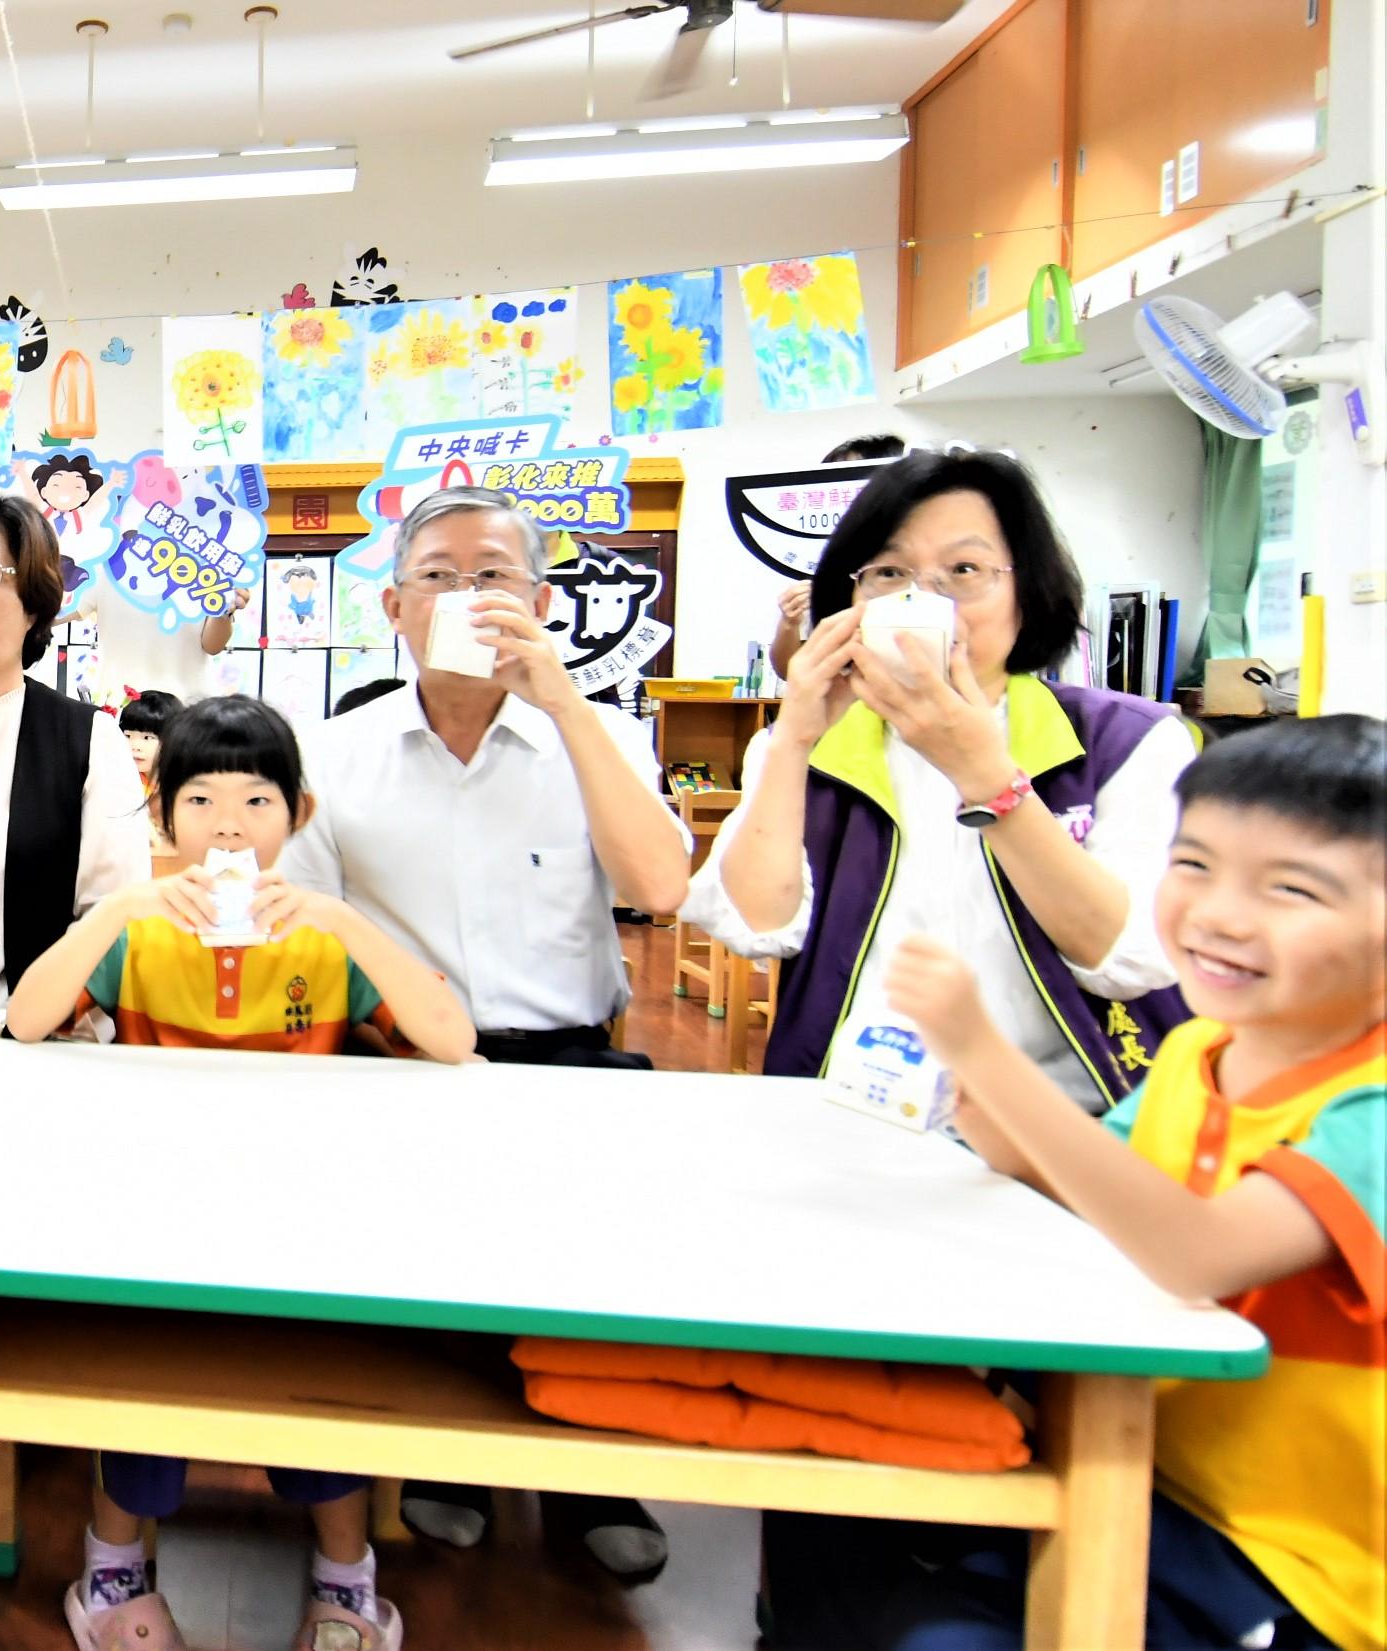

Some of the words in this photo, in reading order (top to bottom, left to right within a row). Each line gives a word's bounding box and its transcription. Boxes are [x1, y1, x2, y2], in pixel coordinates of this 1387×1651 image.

[417, 429, 530, 462] 中央喊卡
[481, 459, 604, 491] 彰化來推
[507, 490, 621, 526] 000萬
[777, 487, 863, 512] 臺灣鮮
[145, 501, 245, 578] 鮮乳飲用率
